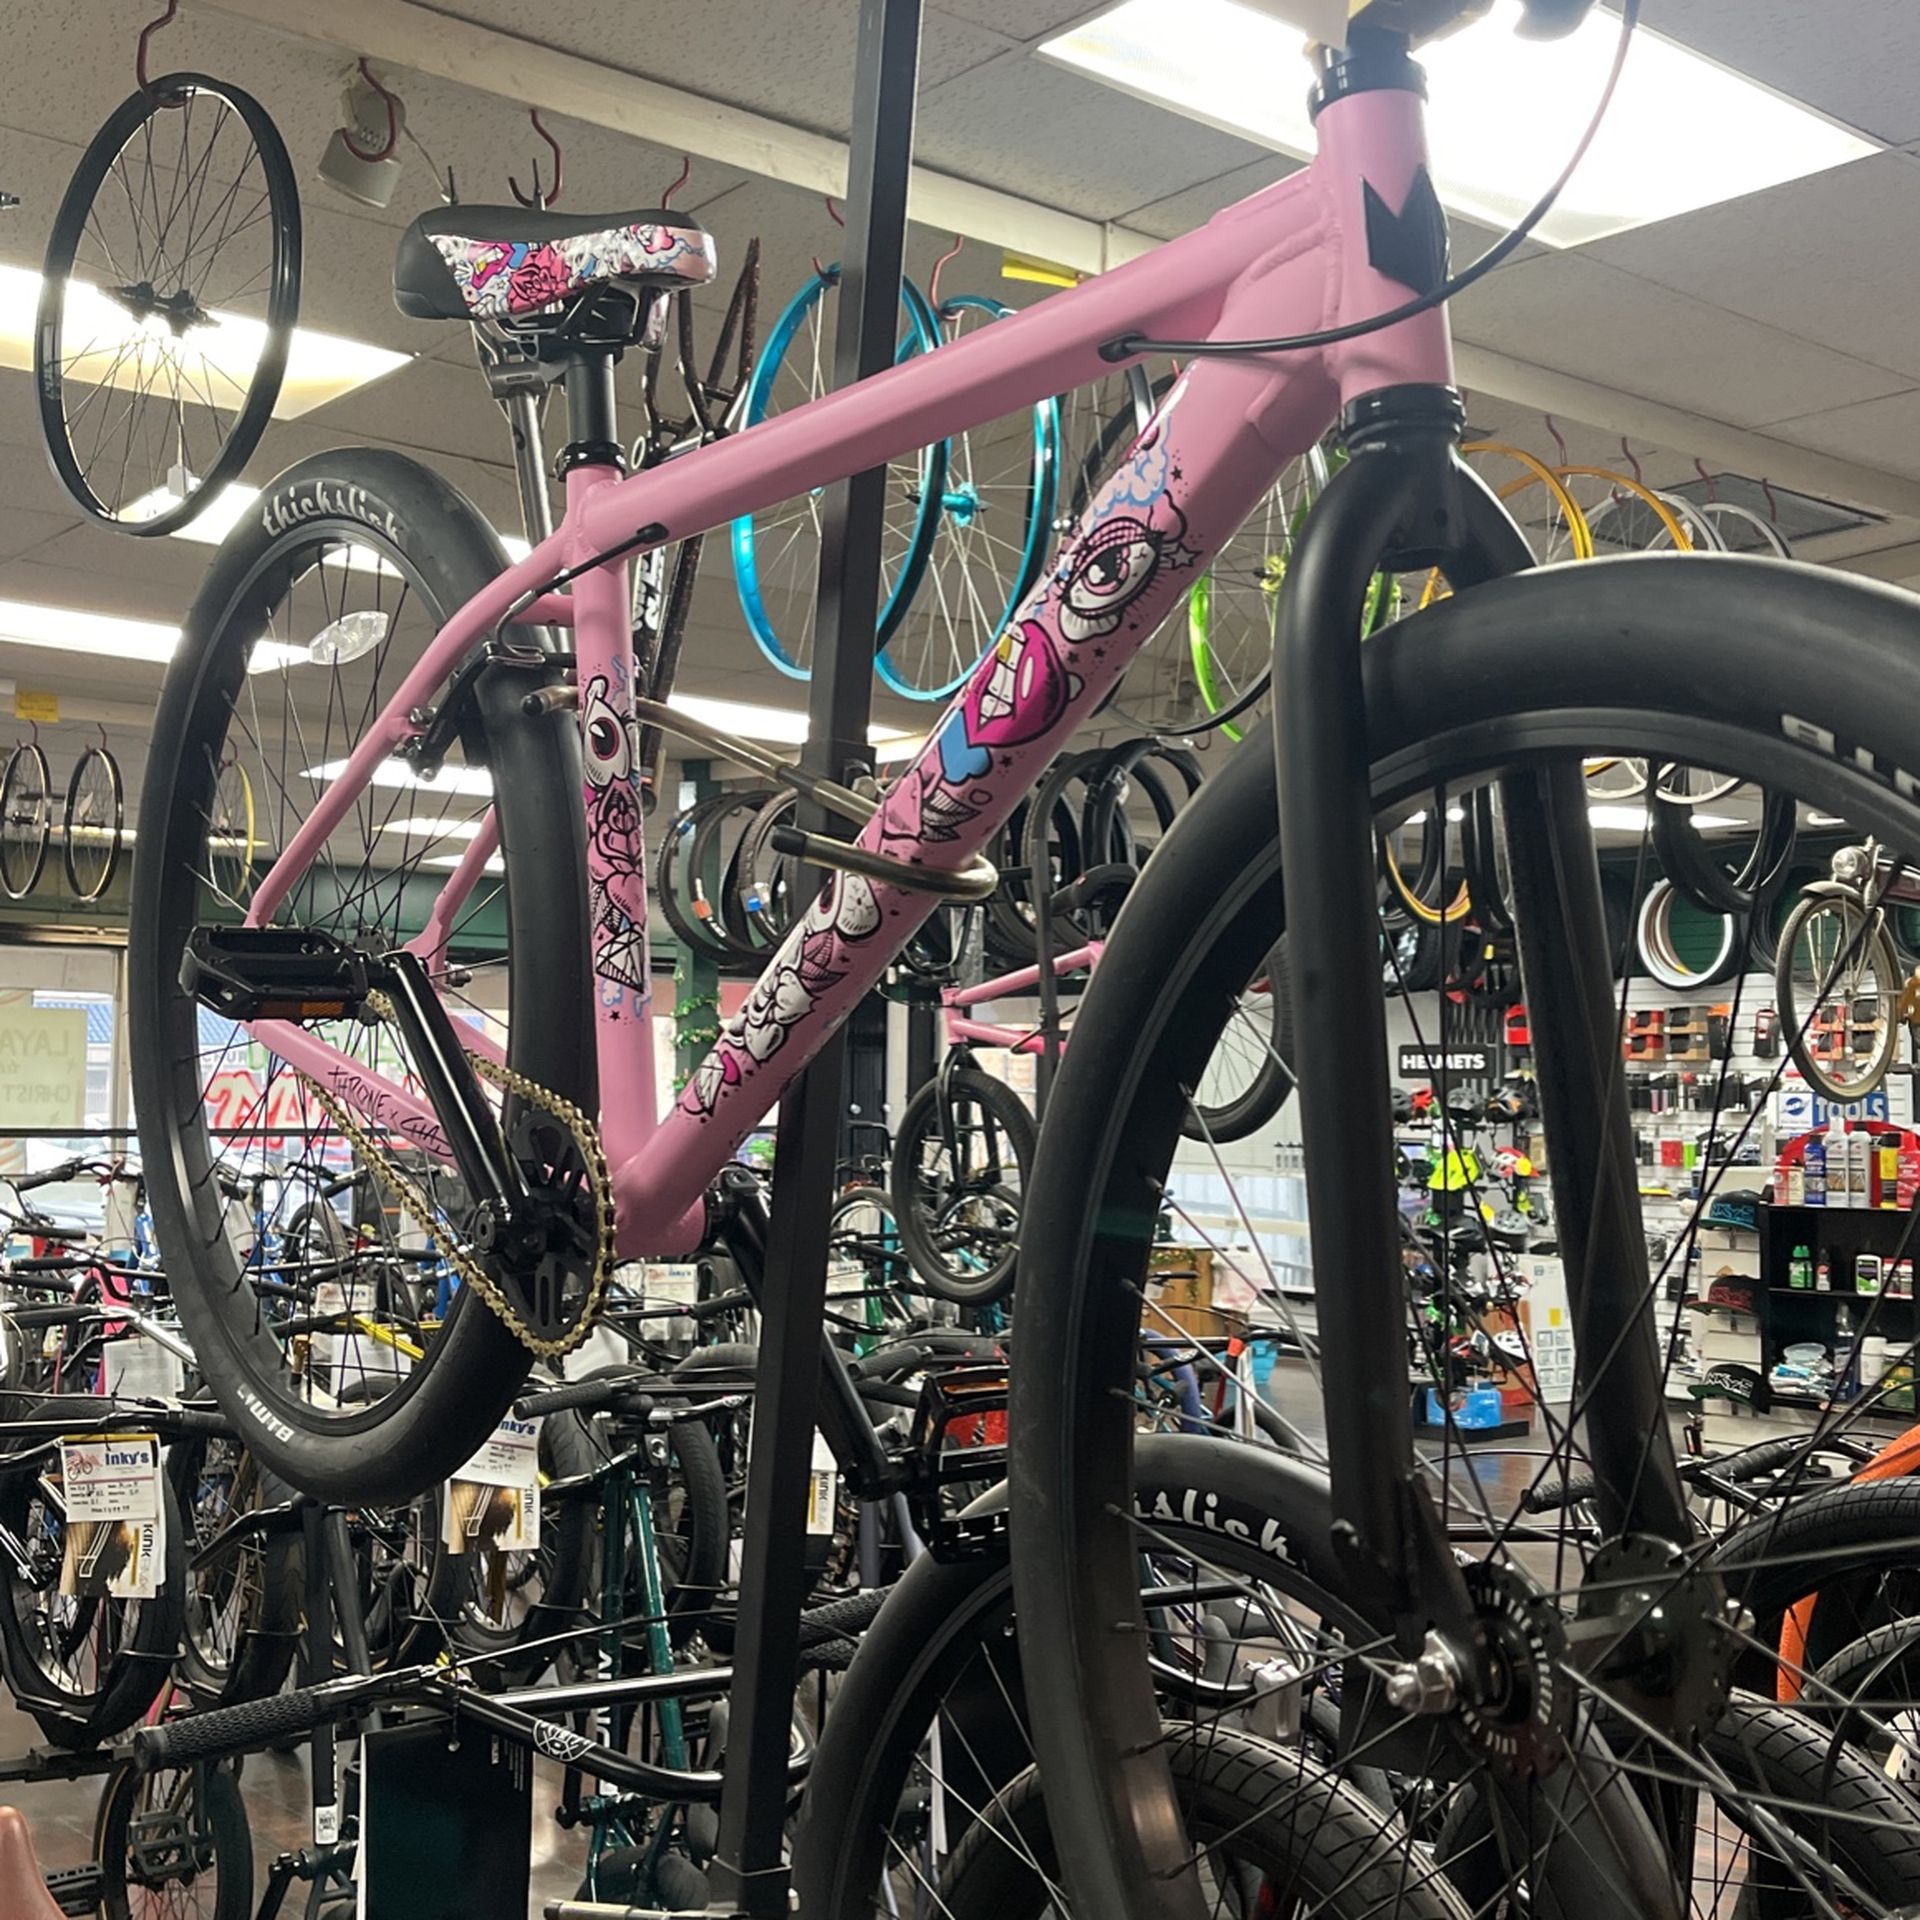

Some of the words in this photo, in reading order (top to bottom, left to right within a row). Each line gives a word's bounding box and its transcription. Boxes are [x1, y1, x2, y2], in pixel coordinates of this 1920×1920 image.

[1401, 1053, 1486, 1070] HELMETS
[328, 1066, 392, 1119] THRONE
[1816, 1096, 1885, 1122] TOOLS
[249, 1400, 295, 1443] WTB
[500, 1420, 537, 1435] nky's
[104, 1450, 150, 1467] Inky's
